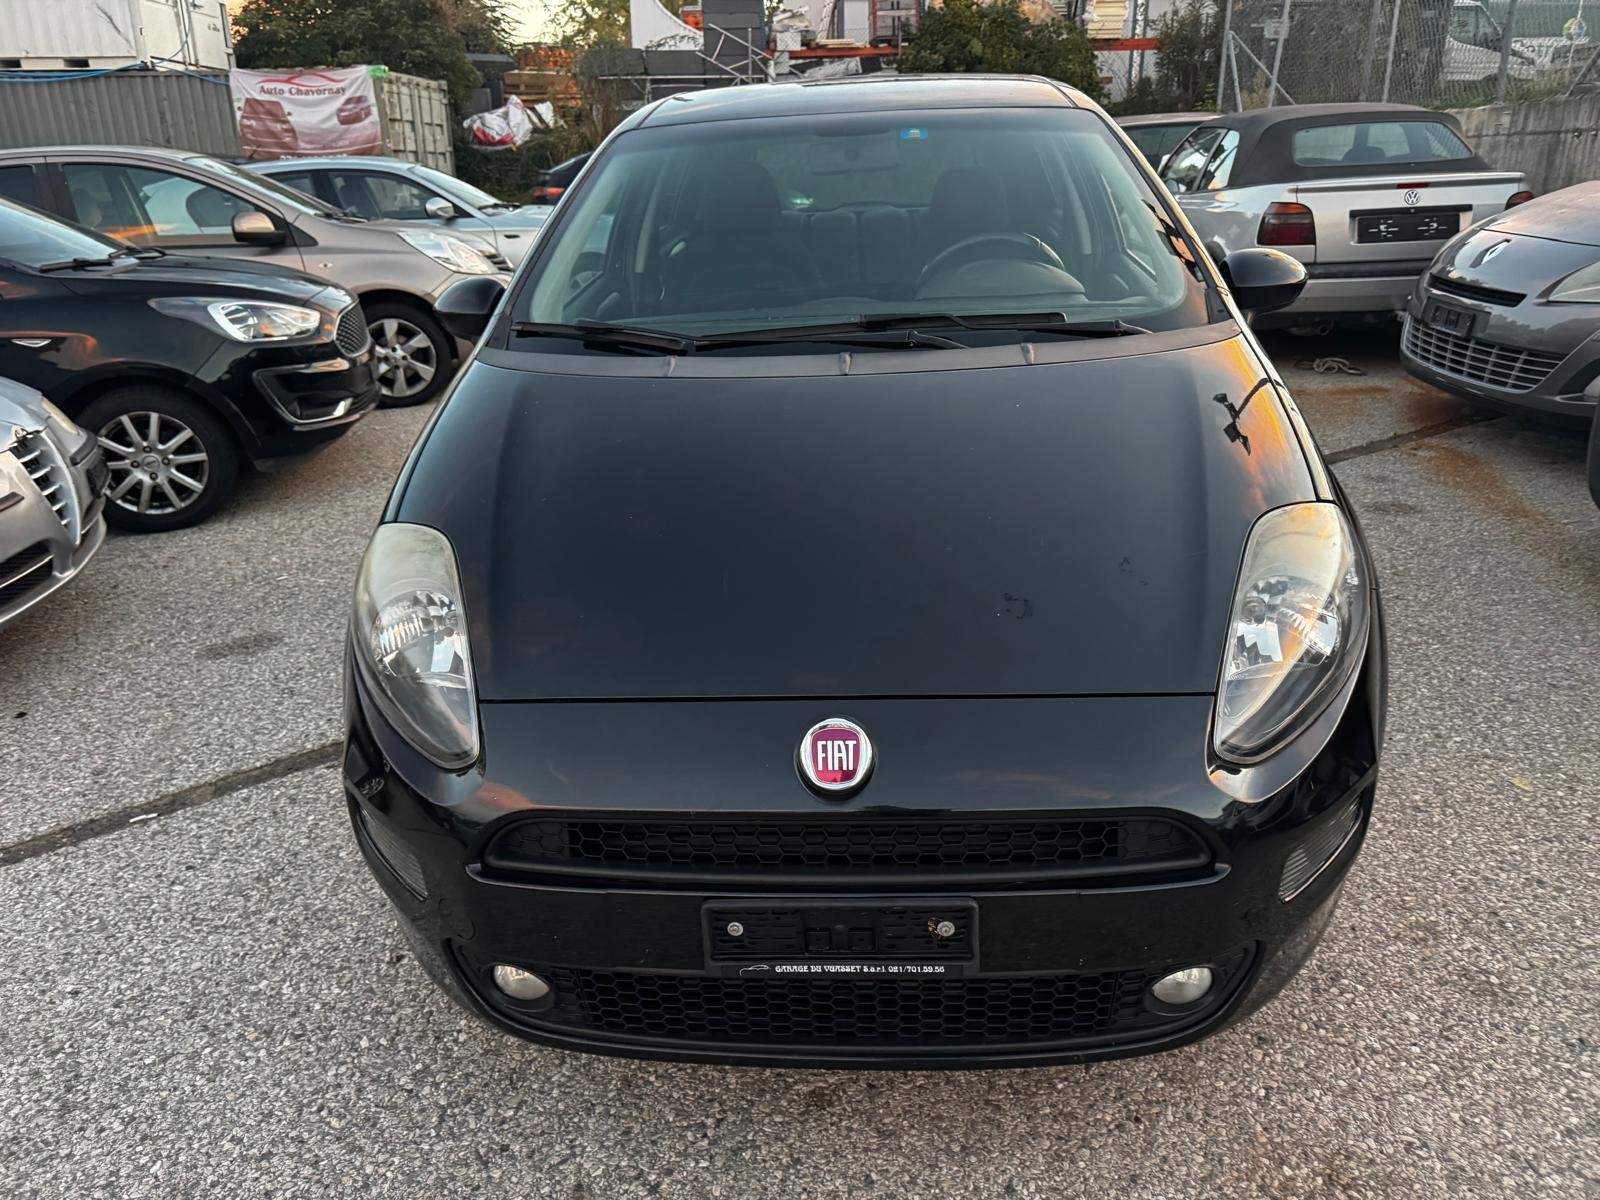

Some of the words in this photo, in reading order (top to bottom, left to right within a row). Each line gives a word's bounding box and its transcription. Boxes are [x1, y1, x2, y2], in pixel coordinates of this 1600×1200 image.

[259, 85, 285, 96] Auto
[288, 86, 347, 96] Chavornay
[816, 740, 857, 771] FIAT
[774, 965, 809, 973] GARAGE
[810, 965, 822, 973] DU
